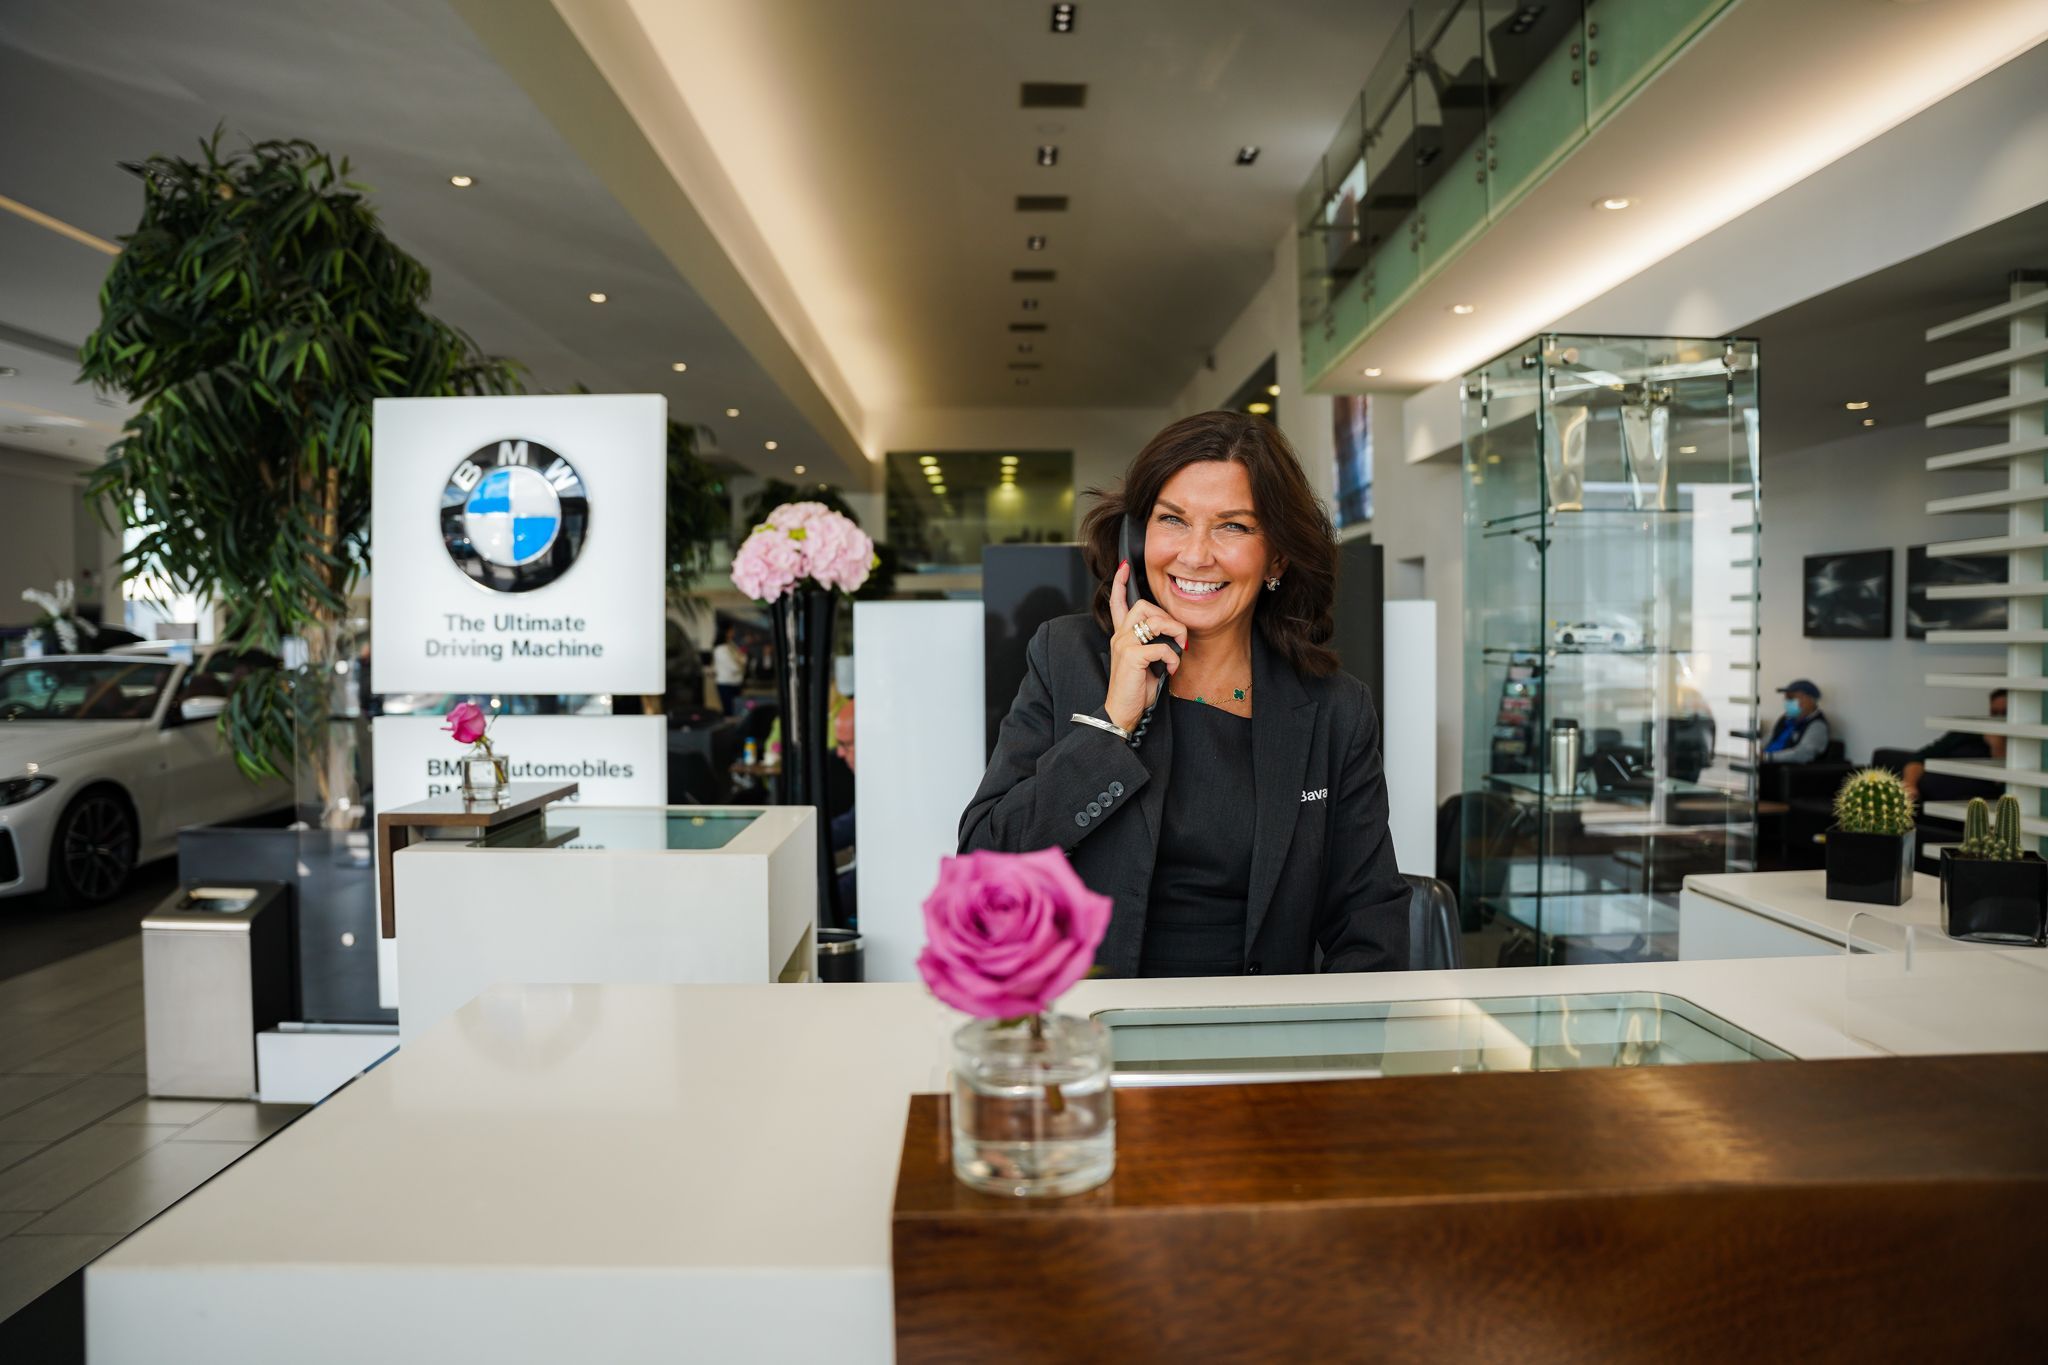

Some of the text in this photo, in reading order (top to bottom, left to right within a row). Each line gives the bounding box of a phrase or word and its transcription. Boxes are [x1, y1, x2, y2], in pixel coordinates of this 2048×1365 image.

[451, 440, 579, 492] BMW
[444, 613, 586, 632] The Ultimate
[425, 638, 603, 662] Driving Machine
[428, 759, 635, 778] BM utomobiles
